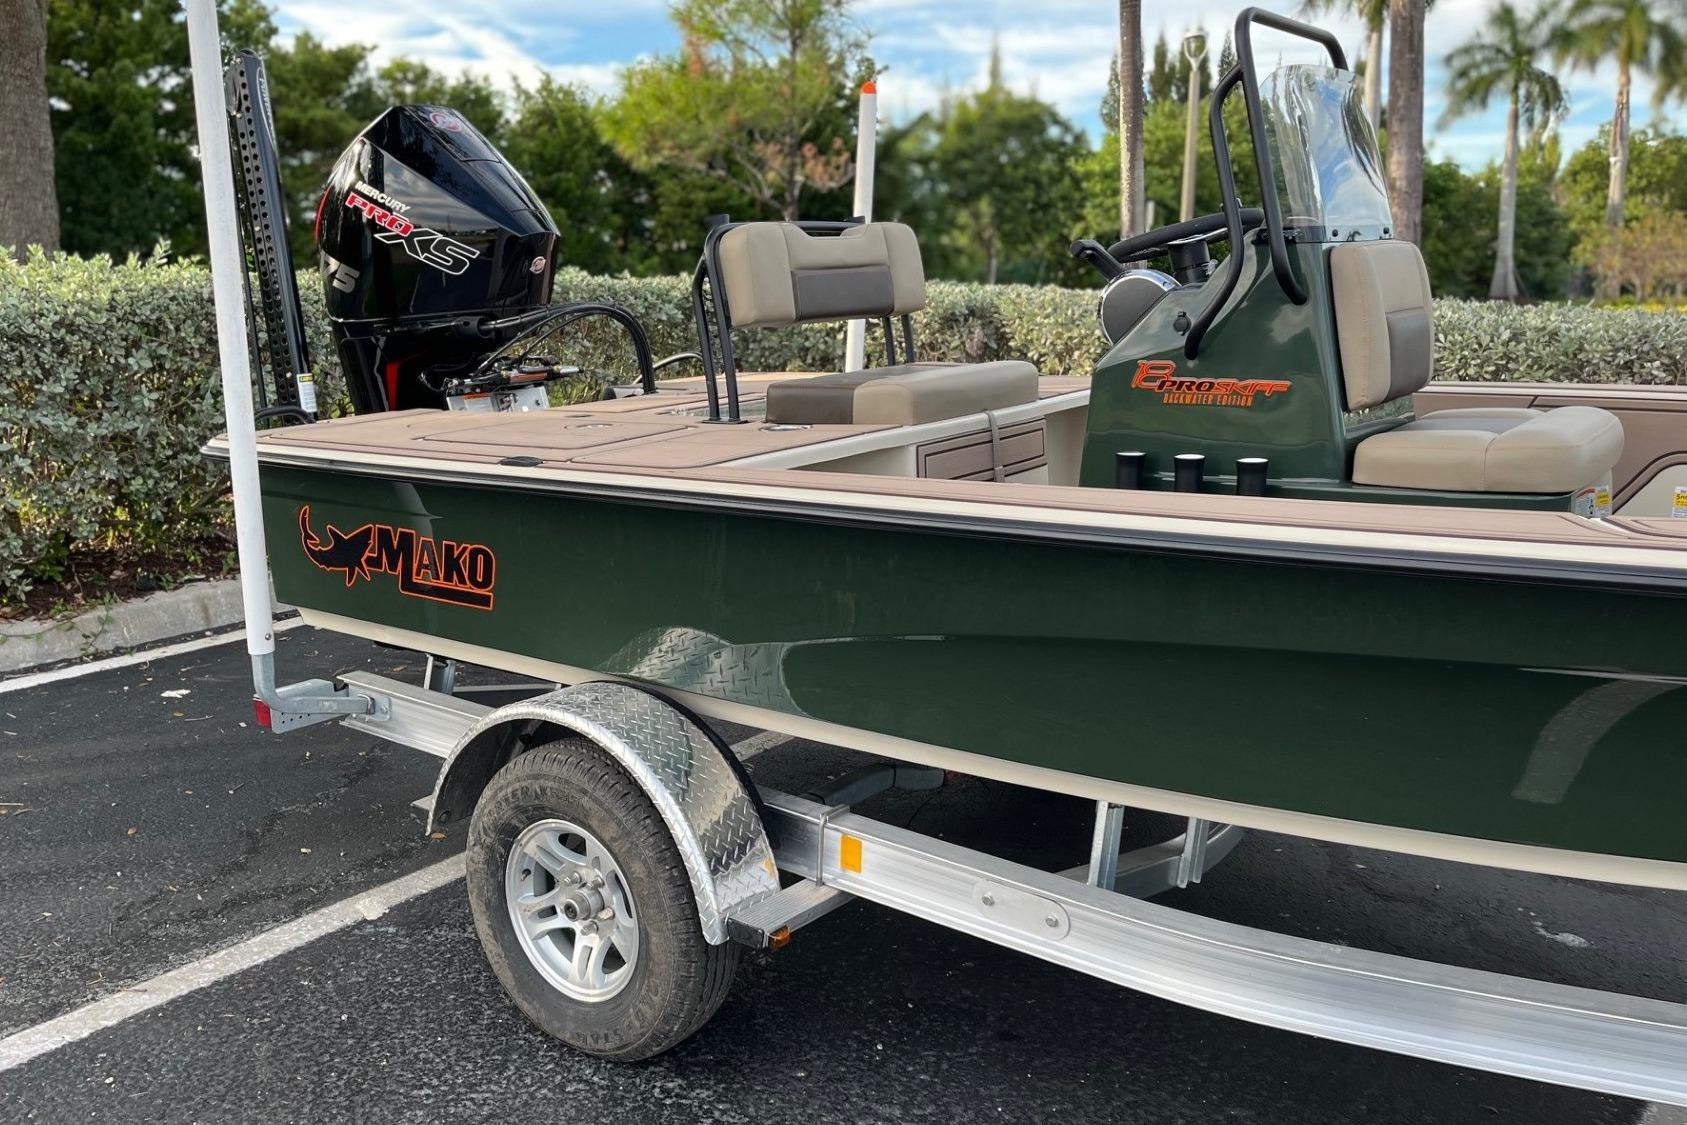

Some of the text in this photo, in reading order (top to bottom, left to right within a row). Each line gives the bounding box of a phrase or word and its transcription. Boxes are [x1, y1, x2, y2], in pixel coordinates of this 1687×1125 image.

[354, 181, 411, 214] MERCURY
[345, 192, 480, 275] PRO XS
[1163, 393, 1255, 407] BACKWATER EDITION
[364, 523, 496, 611] MAKO
